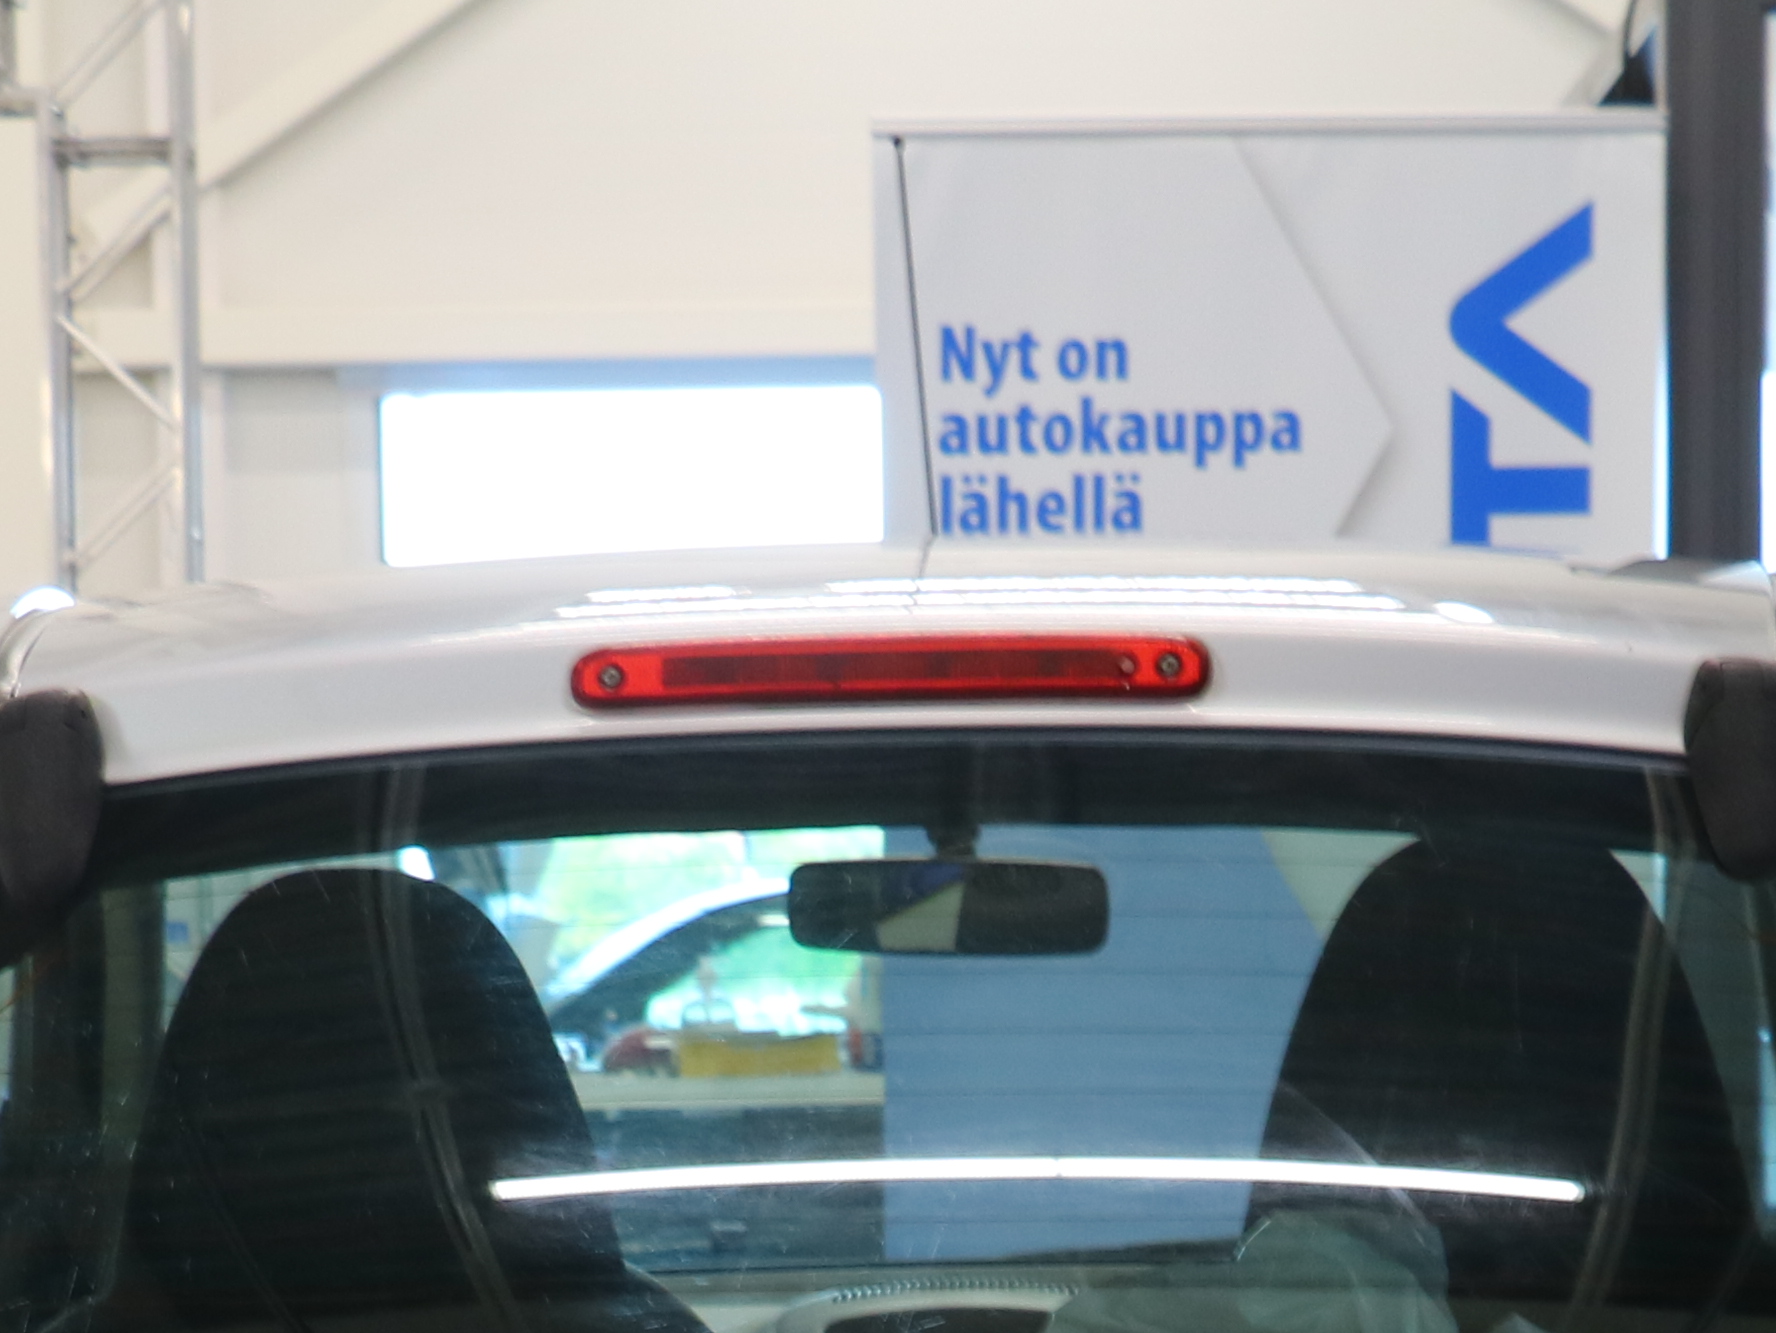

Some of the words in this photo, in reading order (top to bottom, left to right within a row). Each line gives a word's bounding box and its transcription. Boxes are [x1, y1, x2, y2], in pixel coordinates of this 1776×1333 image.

[940, 325, 1040, 398] Nyt
[1057, 338, 1129, 381] on
[939, 396, 1303, 470] autokauppa
[939, 472, 1143, 535] lähellä
